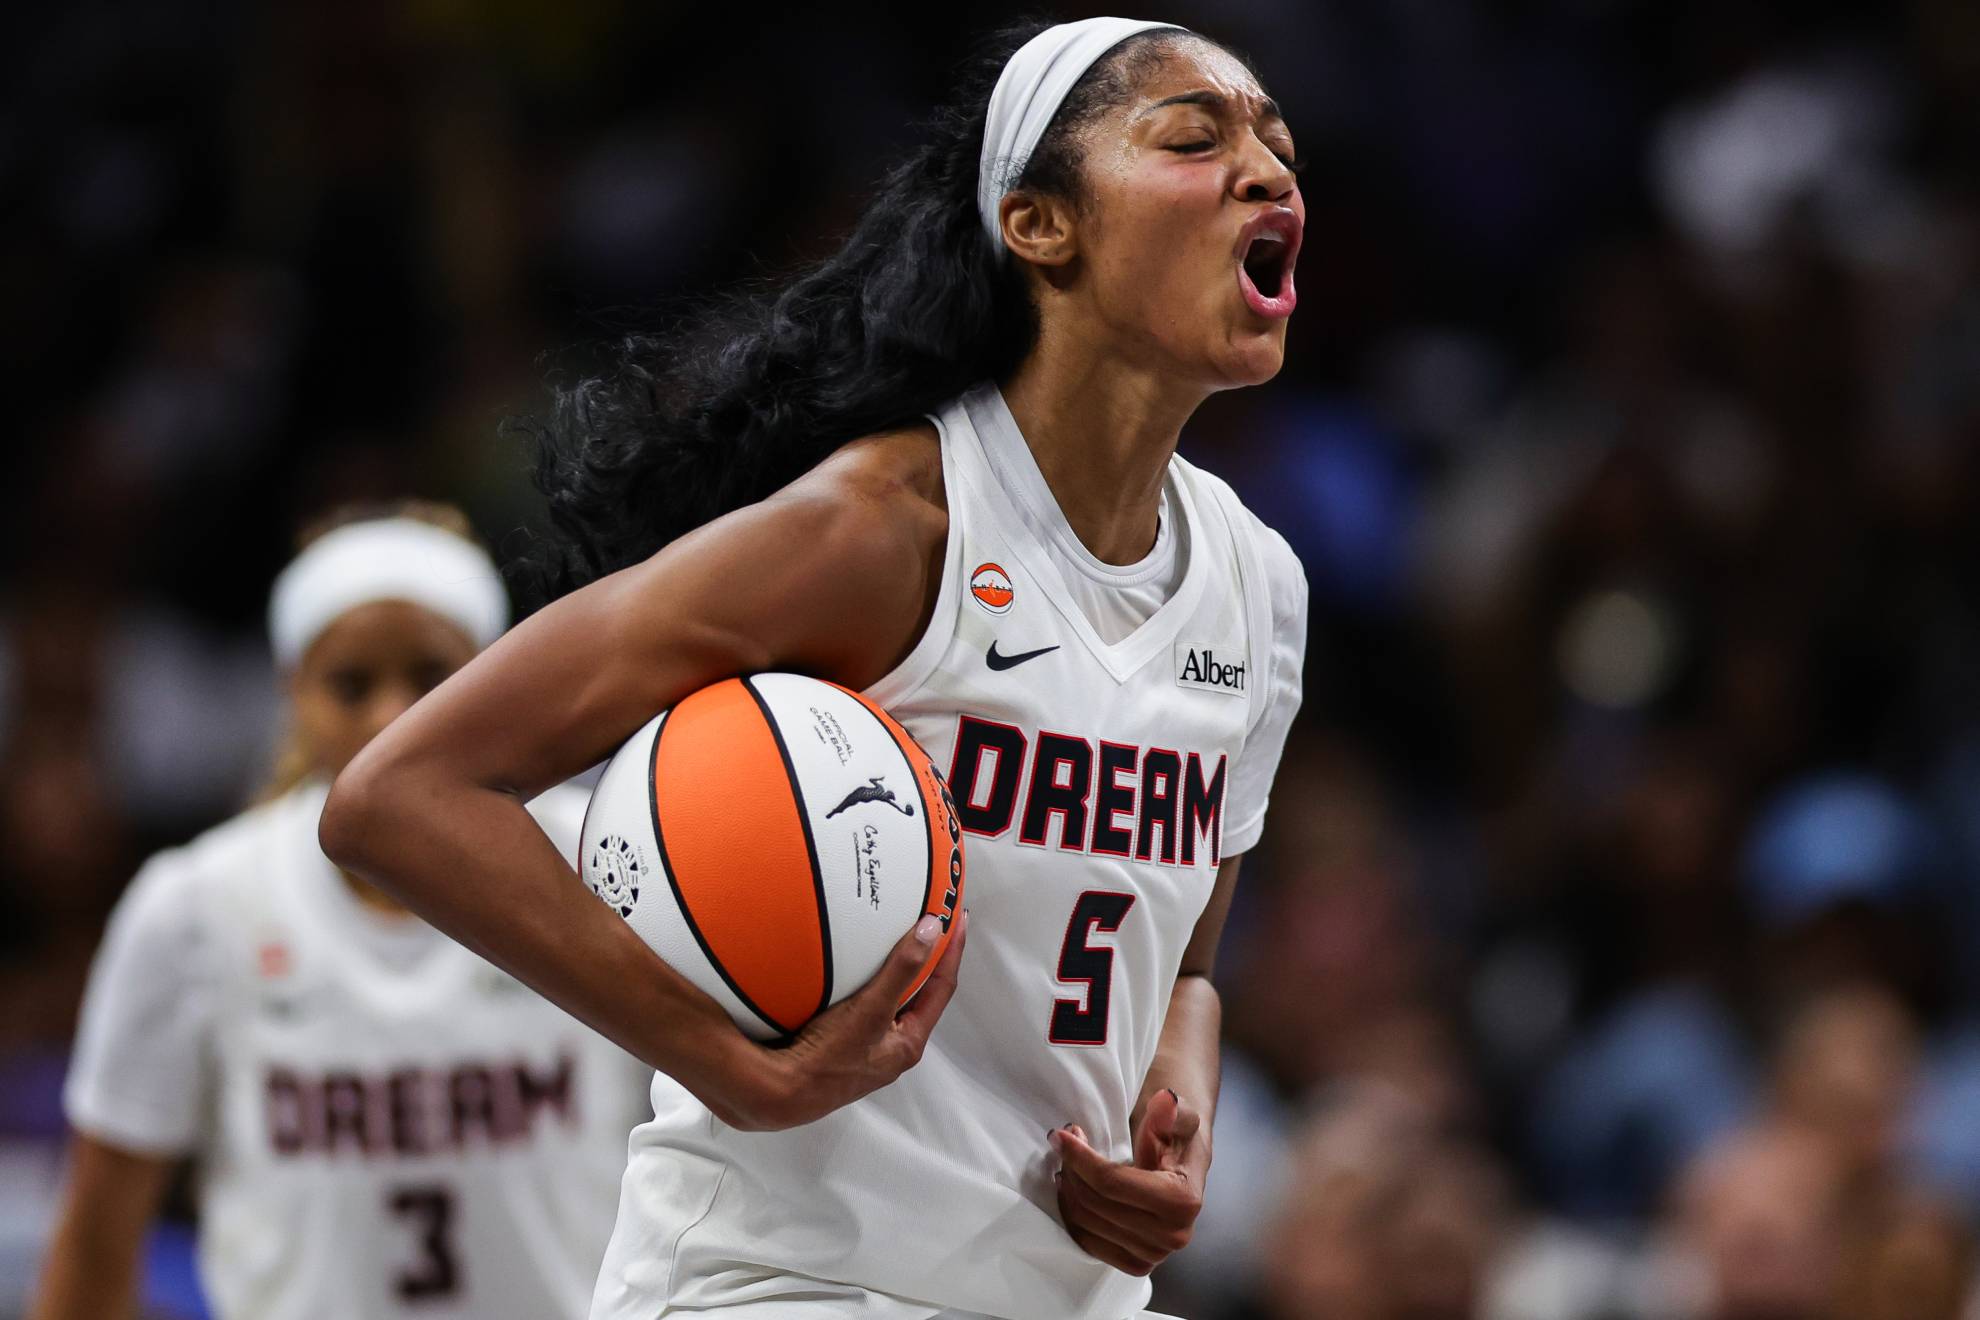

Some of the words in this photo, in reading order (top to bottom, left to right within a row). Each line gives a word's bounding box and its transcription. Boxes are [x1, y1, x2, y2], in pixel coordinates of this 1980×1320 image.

[809, 707, 833, 737] GAME
[830, 736, 848, 767] BALL
[824, 711, 855, 759] OFFICIAL
[947, 714, 1228, 868] DREAM
[1049, 890, 1136, 1046] 5
[266, 1048, 578, 1158] DREAM
[387, 1184, 463, 1303] 3
